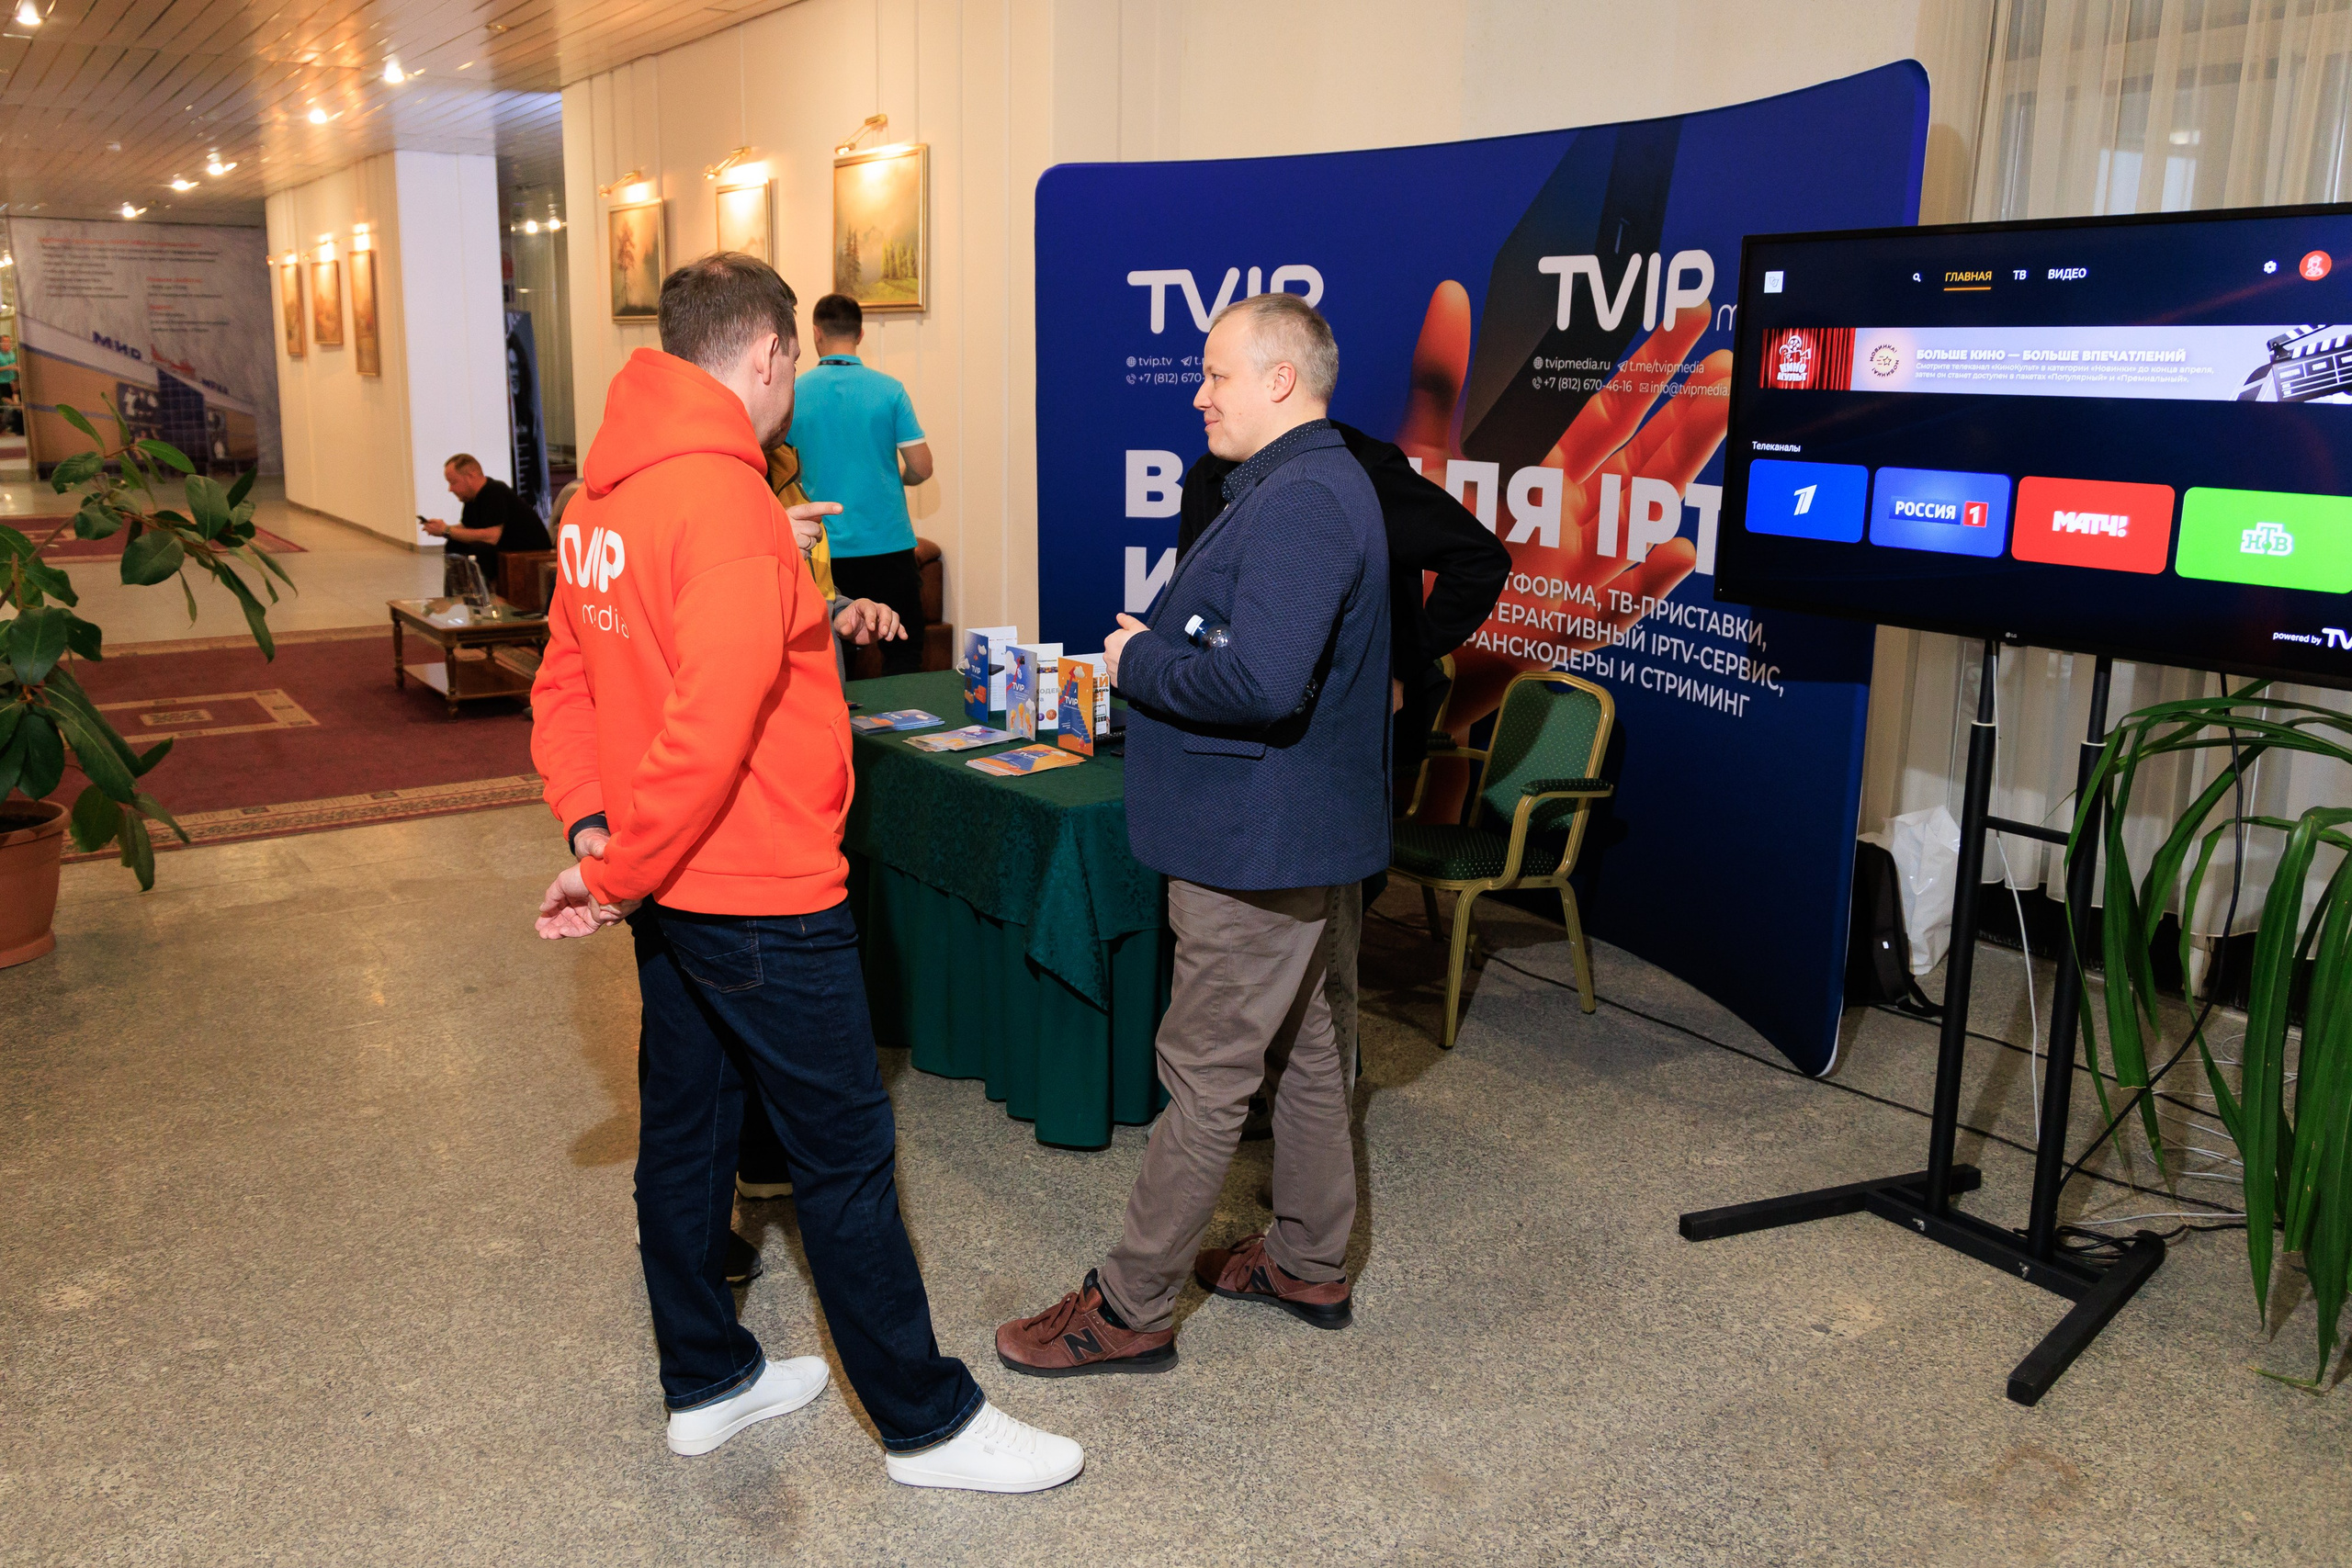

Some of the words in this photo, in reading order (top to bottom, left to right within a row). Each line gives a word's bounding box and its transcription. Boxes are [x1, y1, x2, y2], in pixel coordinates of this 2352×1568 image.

[1945, 271, 1993, 282] ГЛАВНАЯ
[2013, 269, 2027, 280] ТВ
[2048, 267, 2087, 280] ВИДЕО
[1538, 249, 1715, 332] TVIP
[1138, 356, 1172, 367] tvip.tv
[1916, 349, 1967, 360] БОЛЬШЕ
[1970, 349, 2006, 360] КИНО
[2022, 350, 2079, 361] БОЛЬШЕ
[2082, 348, 2187, 362] ВПЕЧАТЛЕНИЙ
[1545, 357, 1611, 370] tvipmedia.ru
[1630, 360, 1704, 374] t.me/tvipmedia
[1916, 362, 1950, 372] Смотрите
[2047, 366, 2088, 374] категории
[2091, 365, 2136, 373] «Новинки»
[1139, 374, 1150, 383] +7
[1154, 373, 1178, 384] (812)
[1973, 373, 2007, 381] доступен
[1544, 378, 1555, 389] +7
[1558, 378, 1581, 391] (812)
[1583, 378, 1633, 392] 670-46-16
[1650, 382, 1730, 397] info@tvipmedia.
[1752, 441, 1801, 452] Телеканалы
[1407, 457, 1564, 548] ЛЯ
[1894, 501, 1956, 520] РОССИЯ
[1969, 505, 1980, 525] 1
[2052, 511, 2128, 537] МАТЧ!
[2240, 522, 2294, 557] НТВ
[1608, 588, 1767, 652] ТВ-ПРИСТАВКИ,
[2273, 631, 2310, 644] powered
[2311, 634, 2322, 646] by
[1488, 602, 1645, 652] ЕРАКТИВНЫЙ
[1652, 633, 1784, 698] IPTV-СЕРВИС,
[971, 664, 981, 674] TVIP
[1012, 682, 1025, 692] TVIP
[1620, 660, 1635, 684] И
[1640, 666, 1750, 717] СТРИМИНГ
[1065, 695, 1079, 706] TVIP
[1062, 1327, 1103, 1362] N
